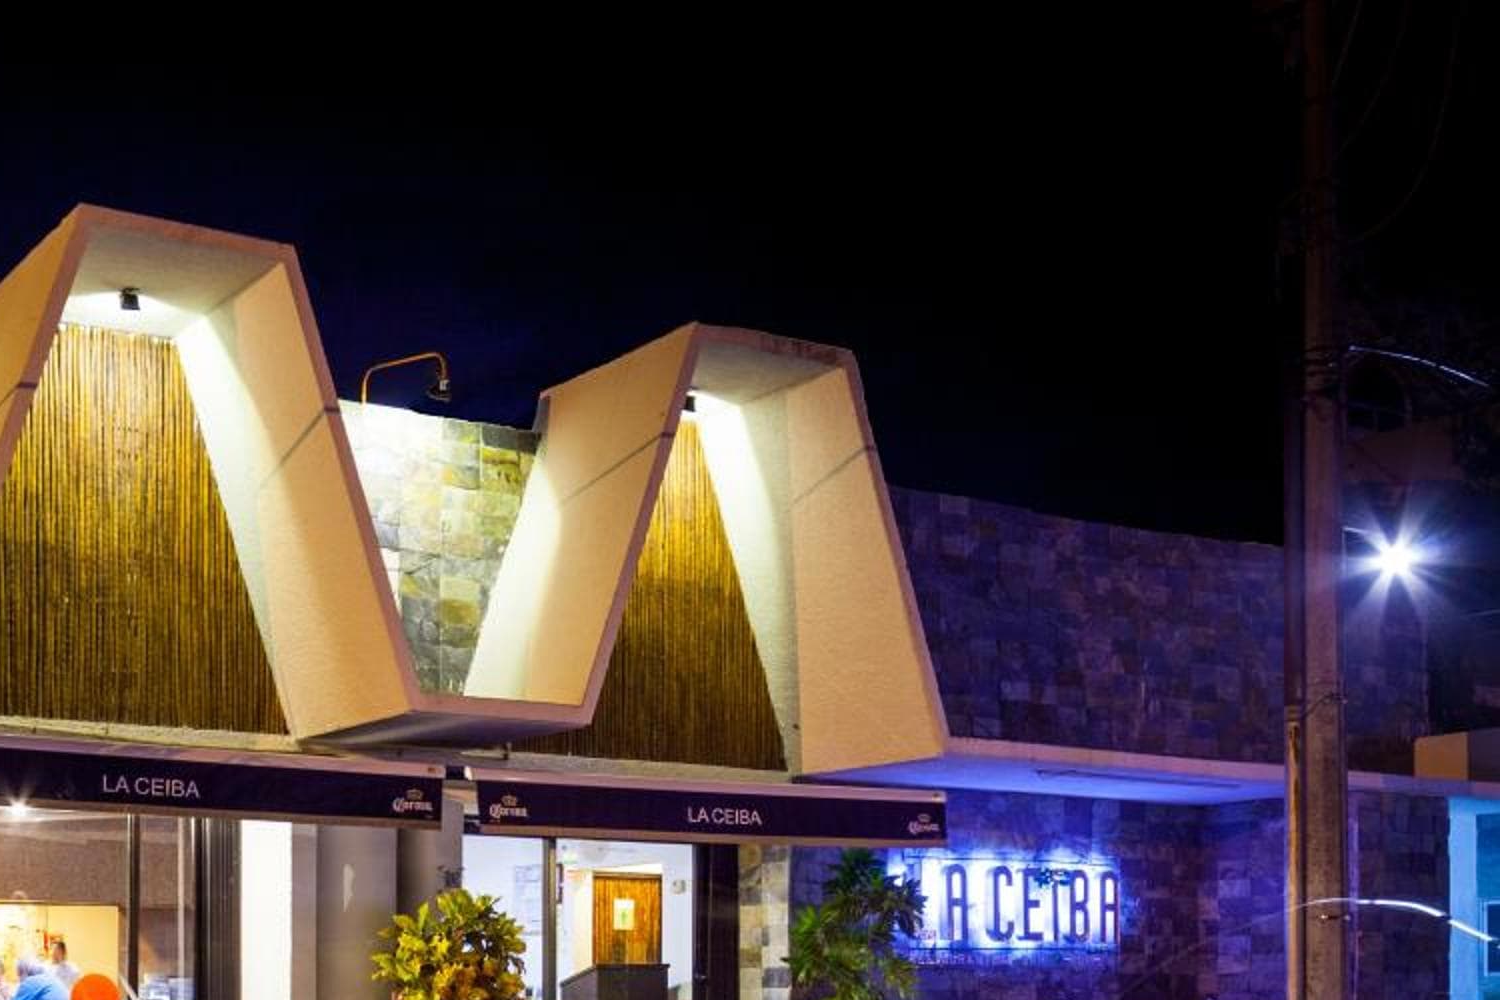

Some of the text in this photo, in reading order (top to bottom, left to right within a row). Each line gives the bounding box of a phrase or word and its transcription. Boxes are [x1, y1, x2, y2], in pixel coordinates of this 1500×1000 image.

[103, 774, 200, 798] LA CEIBA
[687, 806, 763, 826] LA CEIBA
[990, 864, 1119, 945] CEIBA
